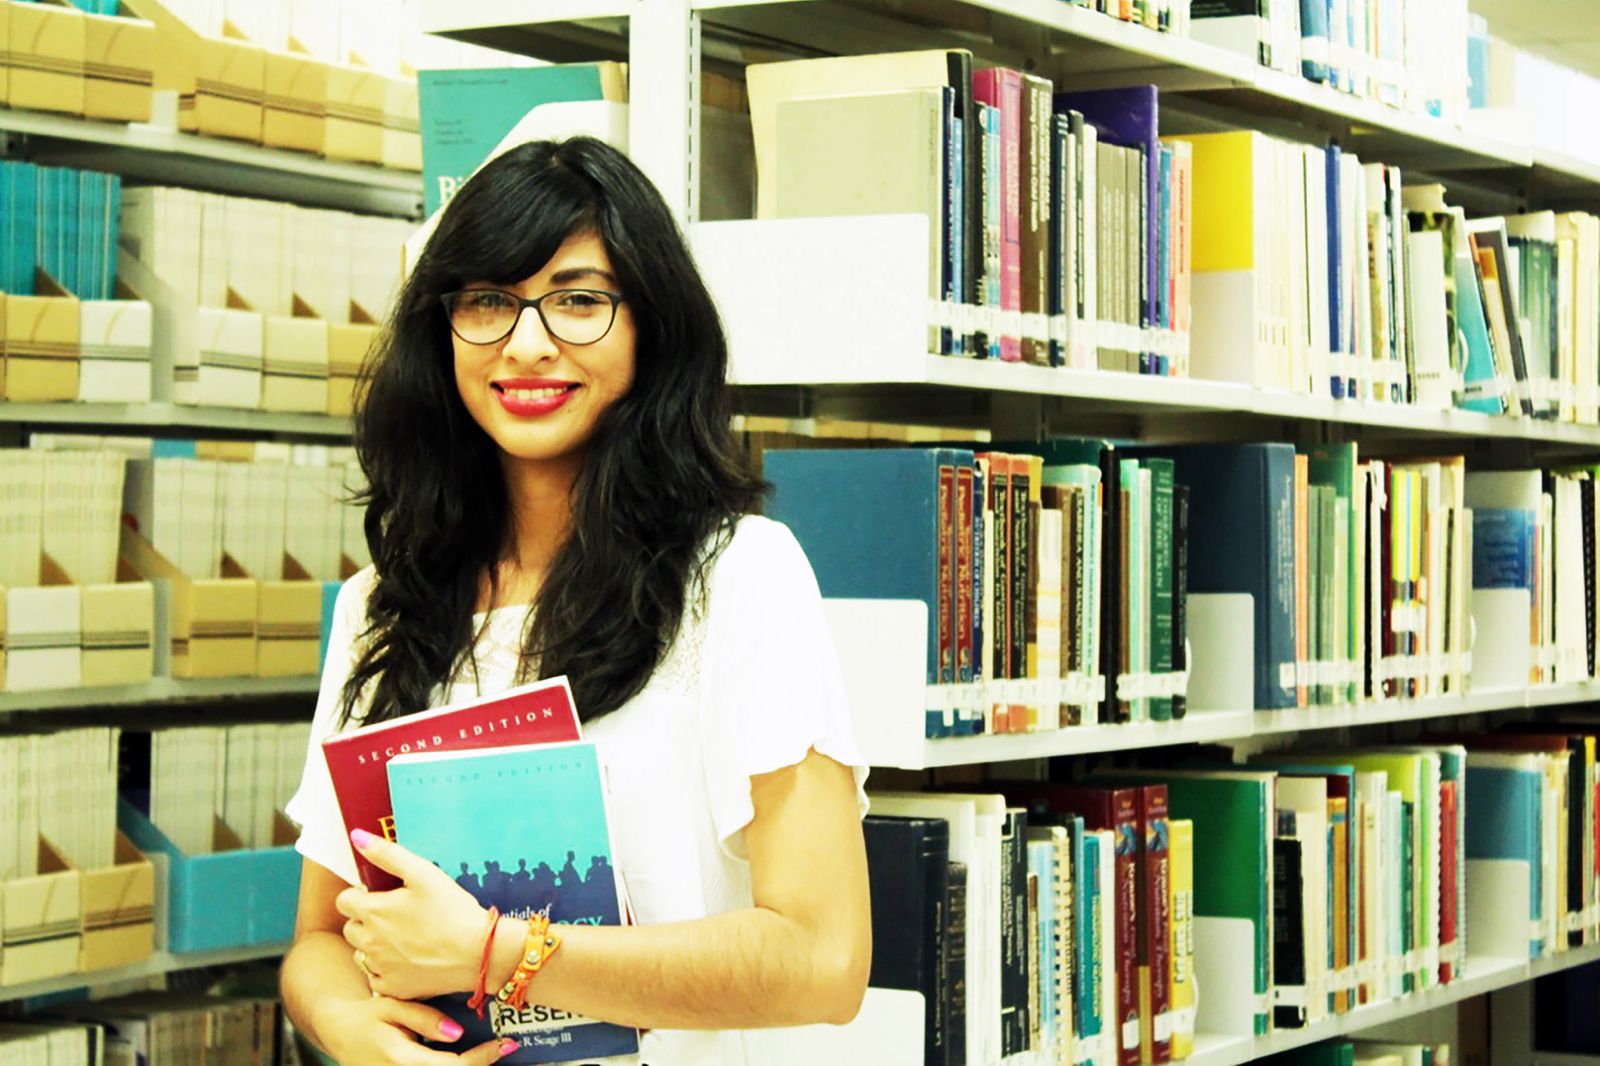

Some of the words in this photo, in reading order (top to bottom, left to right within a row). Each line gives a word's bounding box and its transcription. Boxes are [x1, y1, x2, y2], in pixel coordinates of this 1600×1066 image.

[957, 564, 968, 641] Nutrition
[358, 735, 443, 764] SECOND
[459, 707, 553, 739] EDITION
[538, 903, 552, 919] of
[1161, 858, 1169, 918] Krause's
[499, 1004, 584, 1027] RESE
